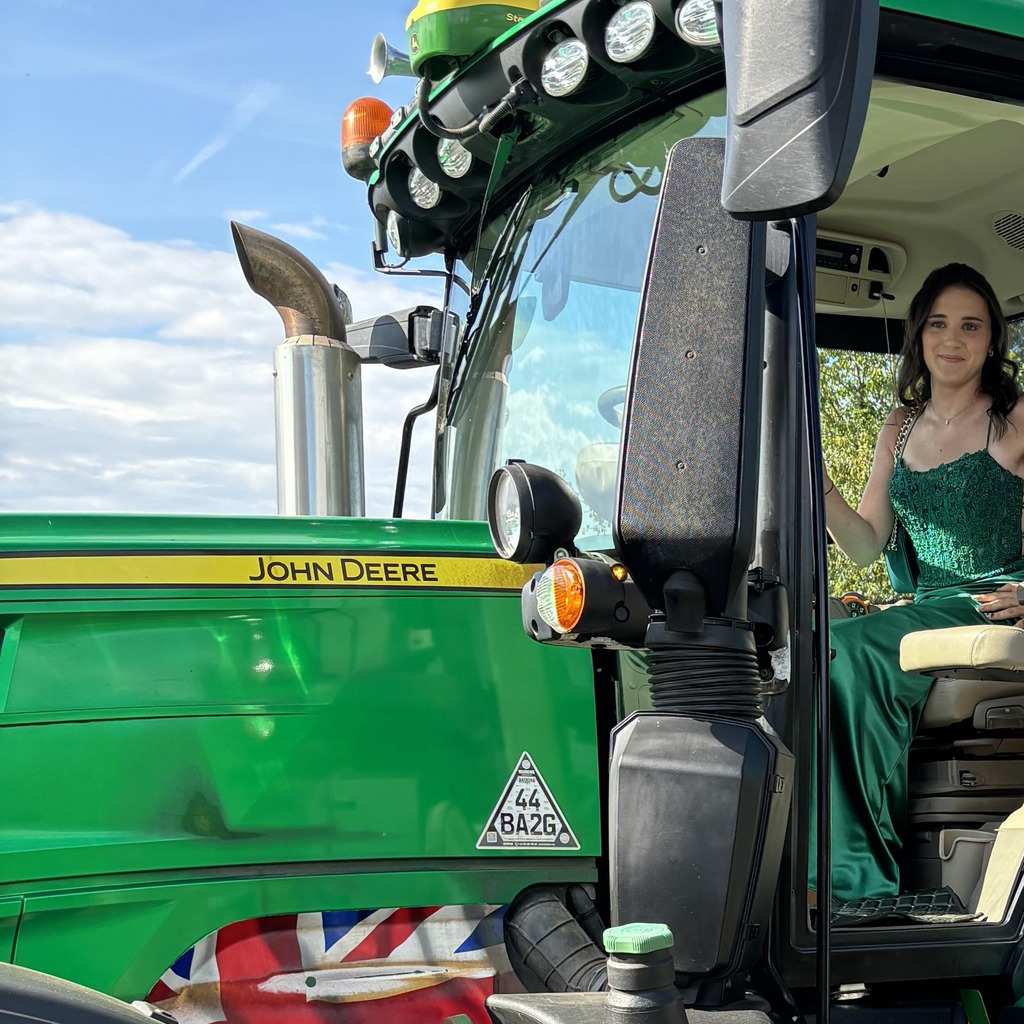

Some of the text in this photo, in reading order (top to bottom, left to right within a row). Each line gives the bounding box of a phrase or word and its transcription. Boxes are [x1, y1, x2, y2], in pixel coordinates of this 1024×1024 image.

[249, 557, 439, 582] JOHN DEERE
[515, 788, 541, 812] 44
[500, 812, 557, 836] BA2G
